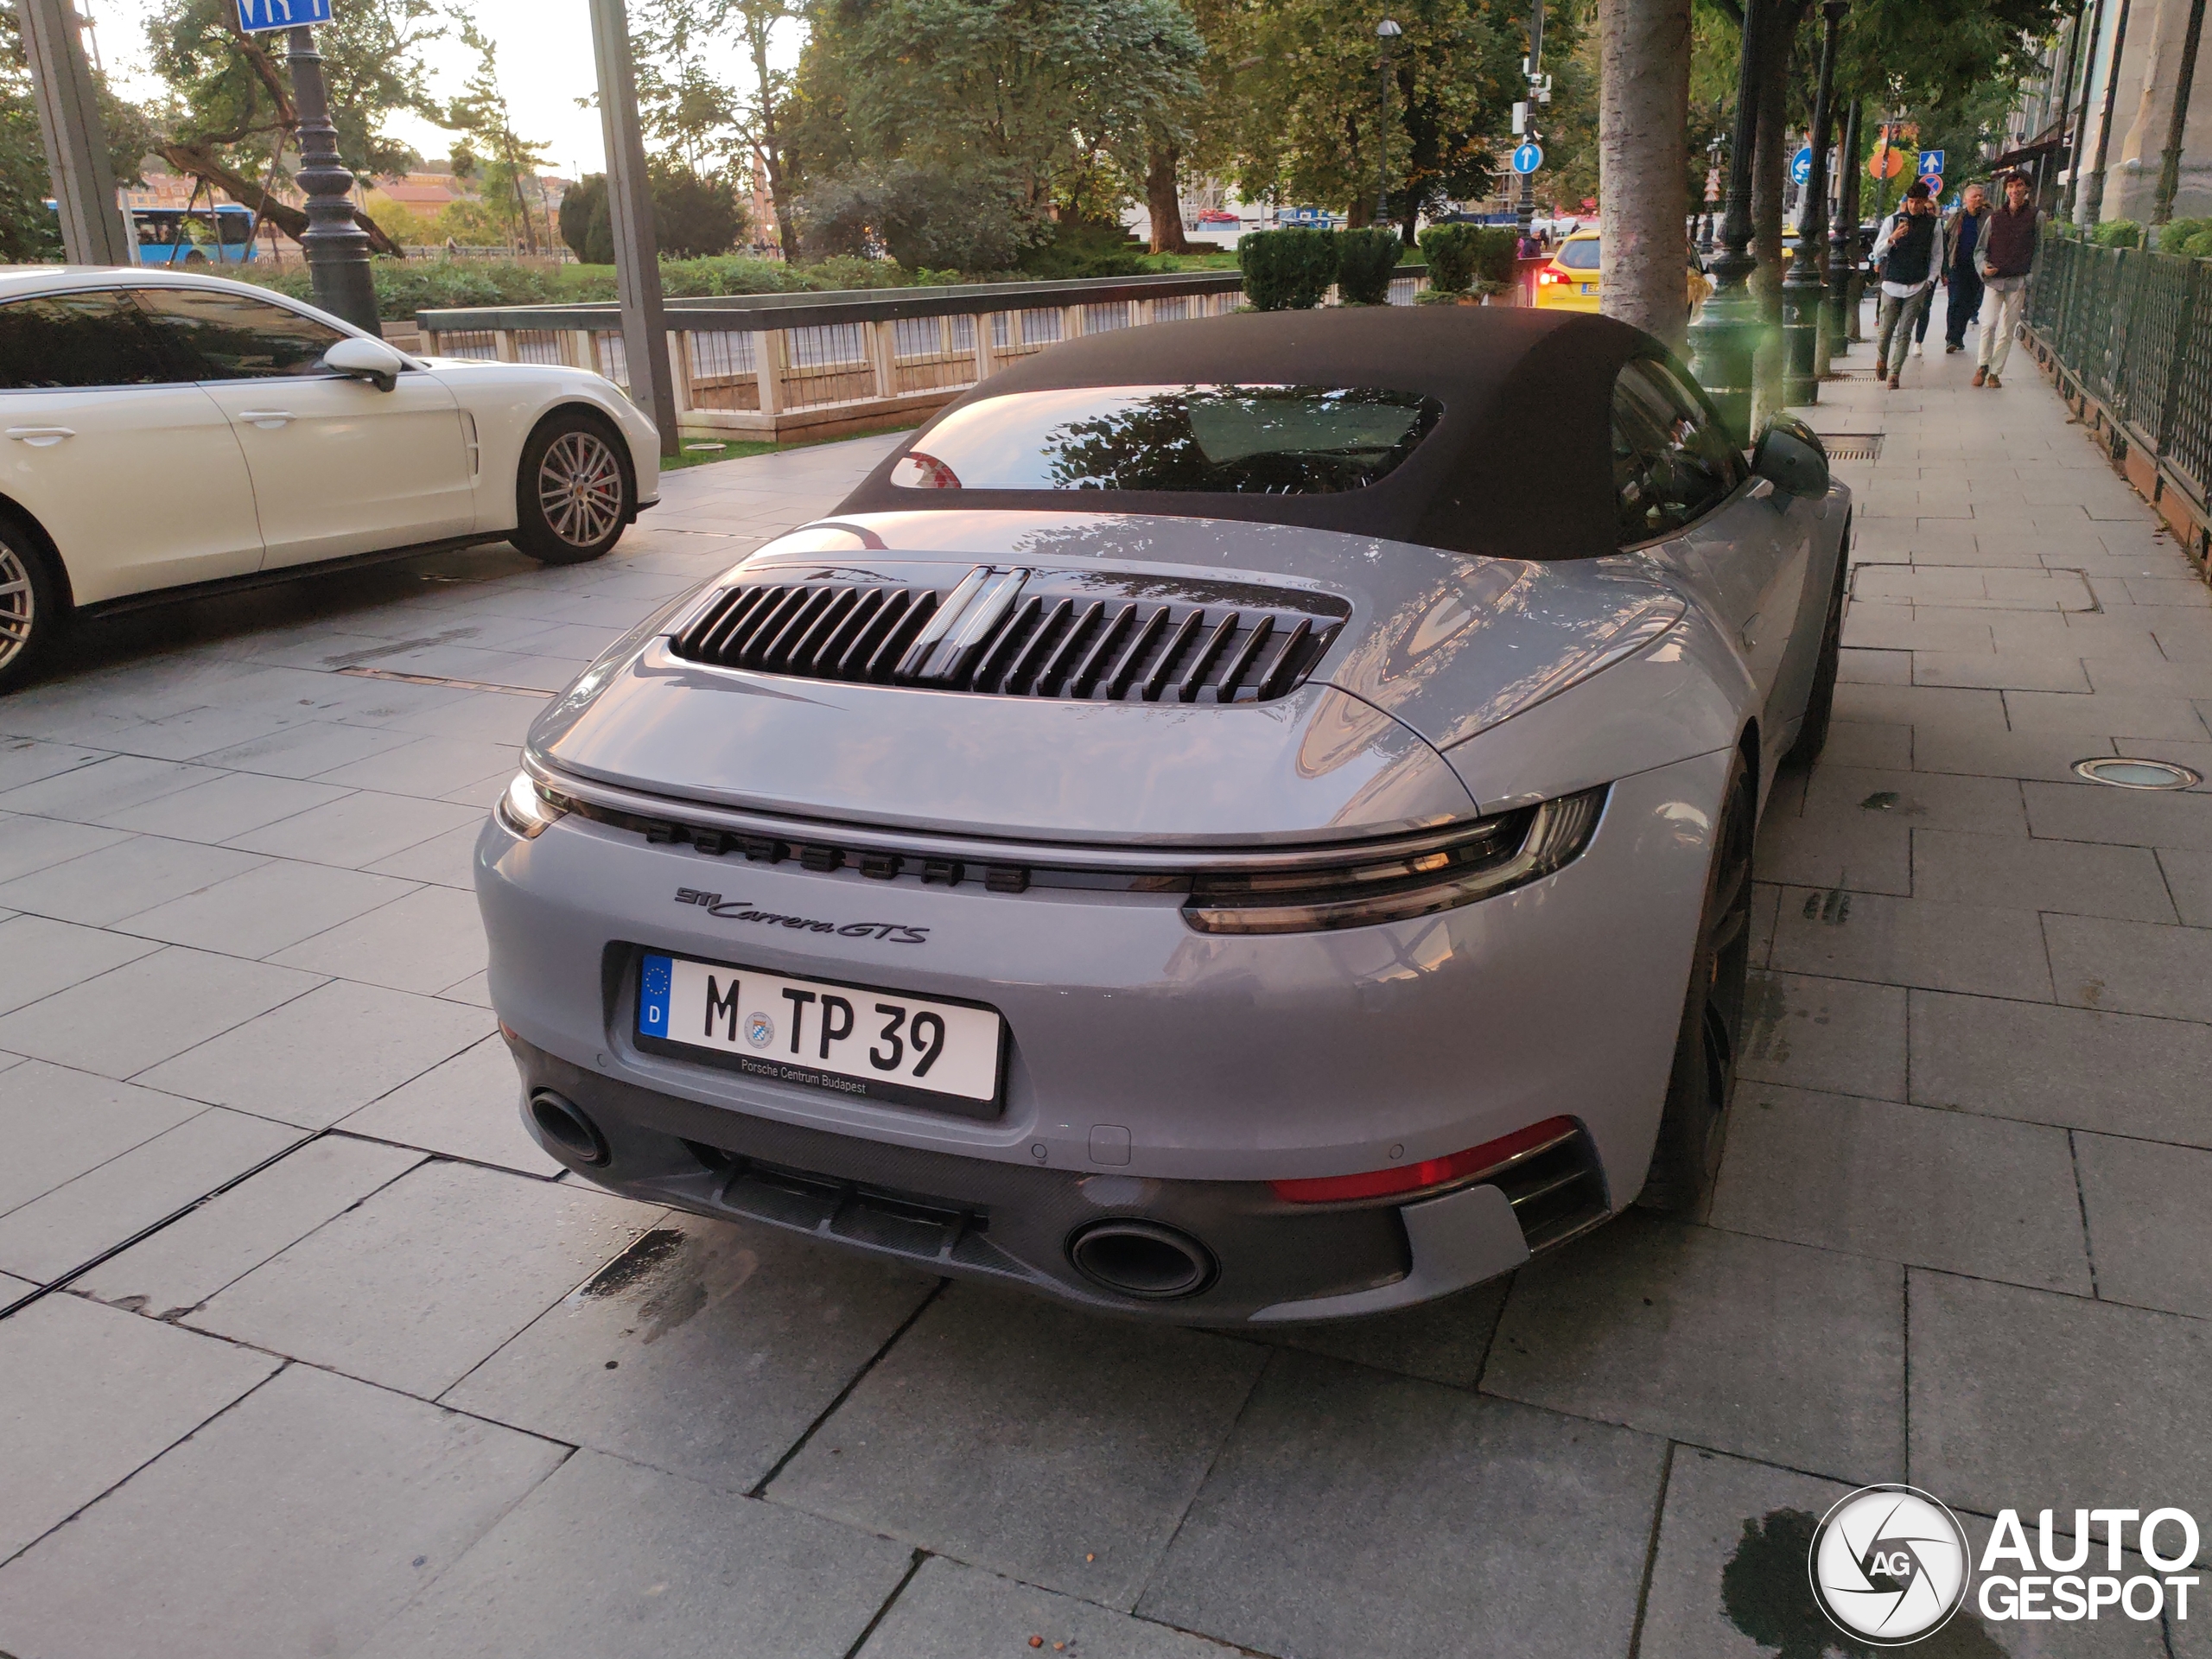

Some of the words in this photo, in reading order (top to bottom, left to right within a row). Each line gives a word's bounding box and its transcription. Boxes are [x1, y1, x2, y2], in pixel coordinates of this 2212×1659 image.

[674, 887, 722, 907] 911
[707, 901, 835, 933] Carrera
[836, 922, 931, 944] GTS
[648, 1005, 661, 1024] D
[704, 975, 741, 1042] M
[781, 988, 855, 1060] TP
[869, 1002, 945, 1077] 39
[741, 1058, 779, 1077] Porsche
[780, 1066, 820, 1085] Centrum
[822, 1074, 867, 1095] Budapest
